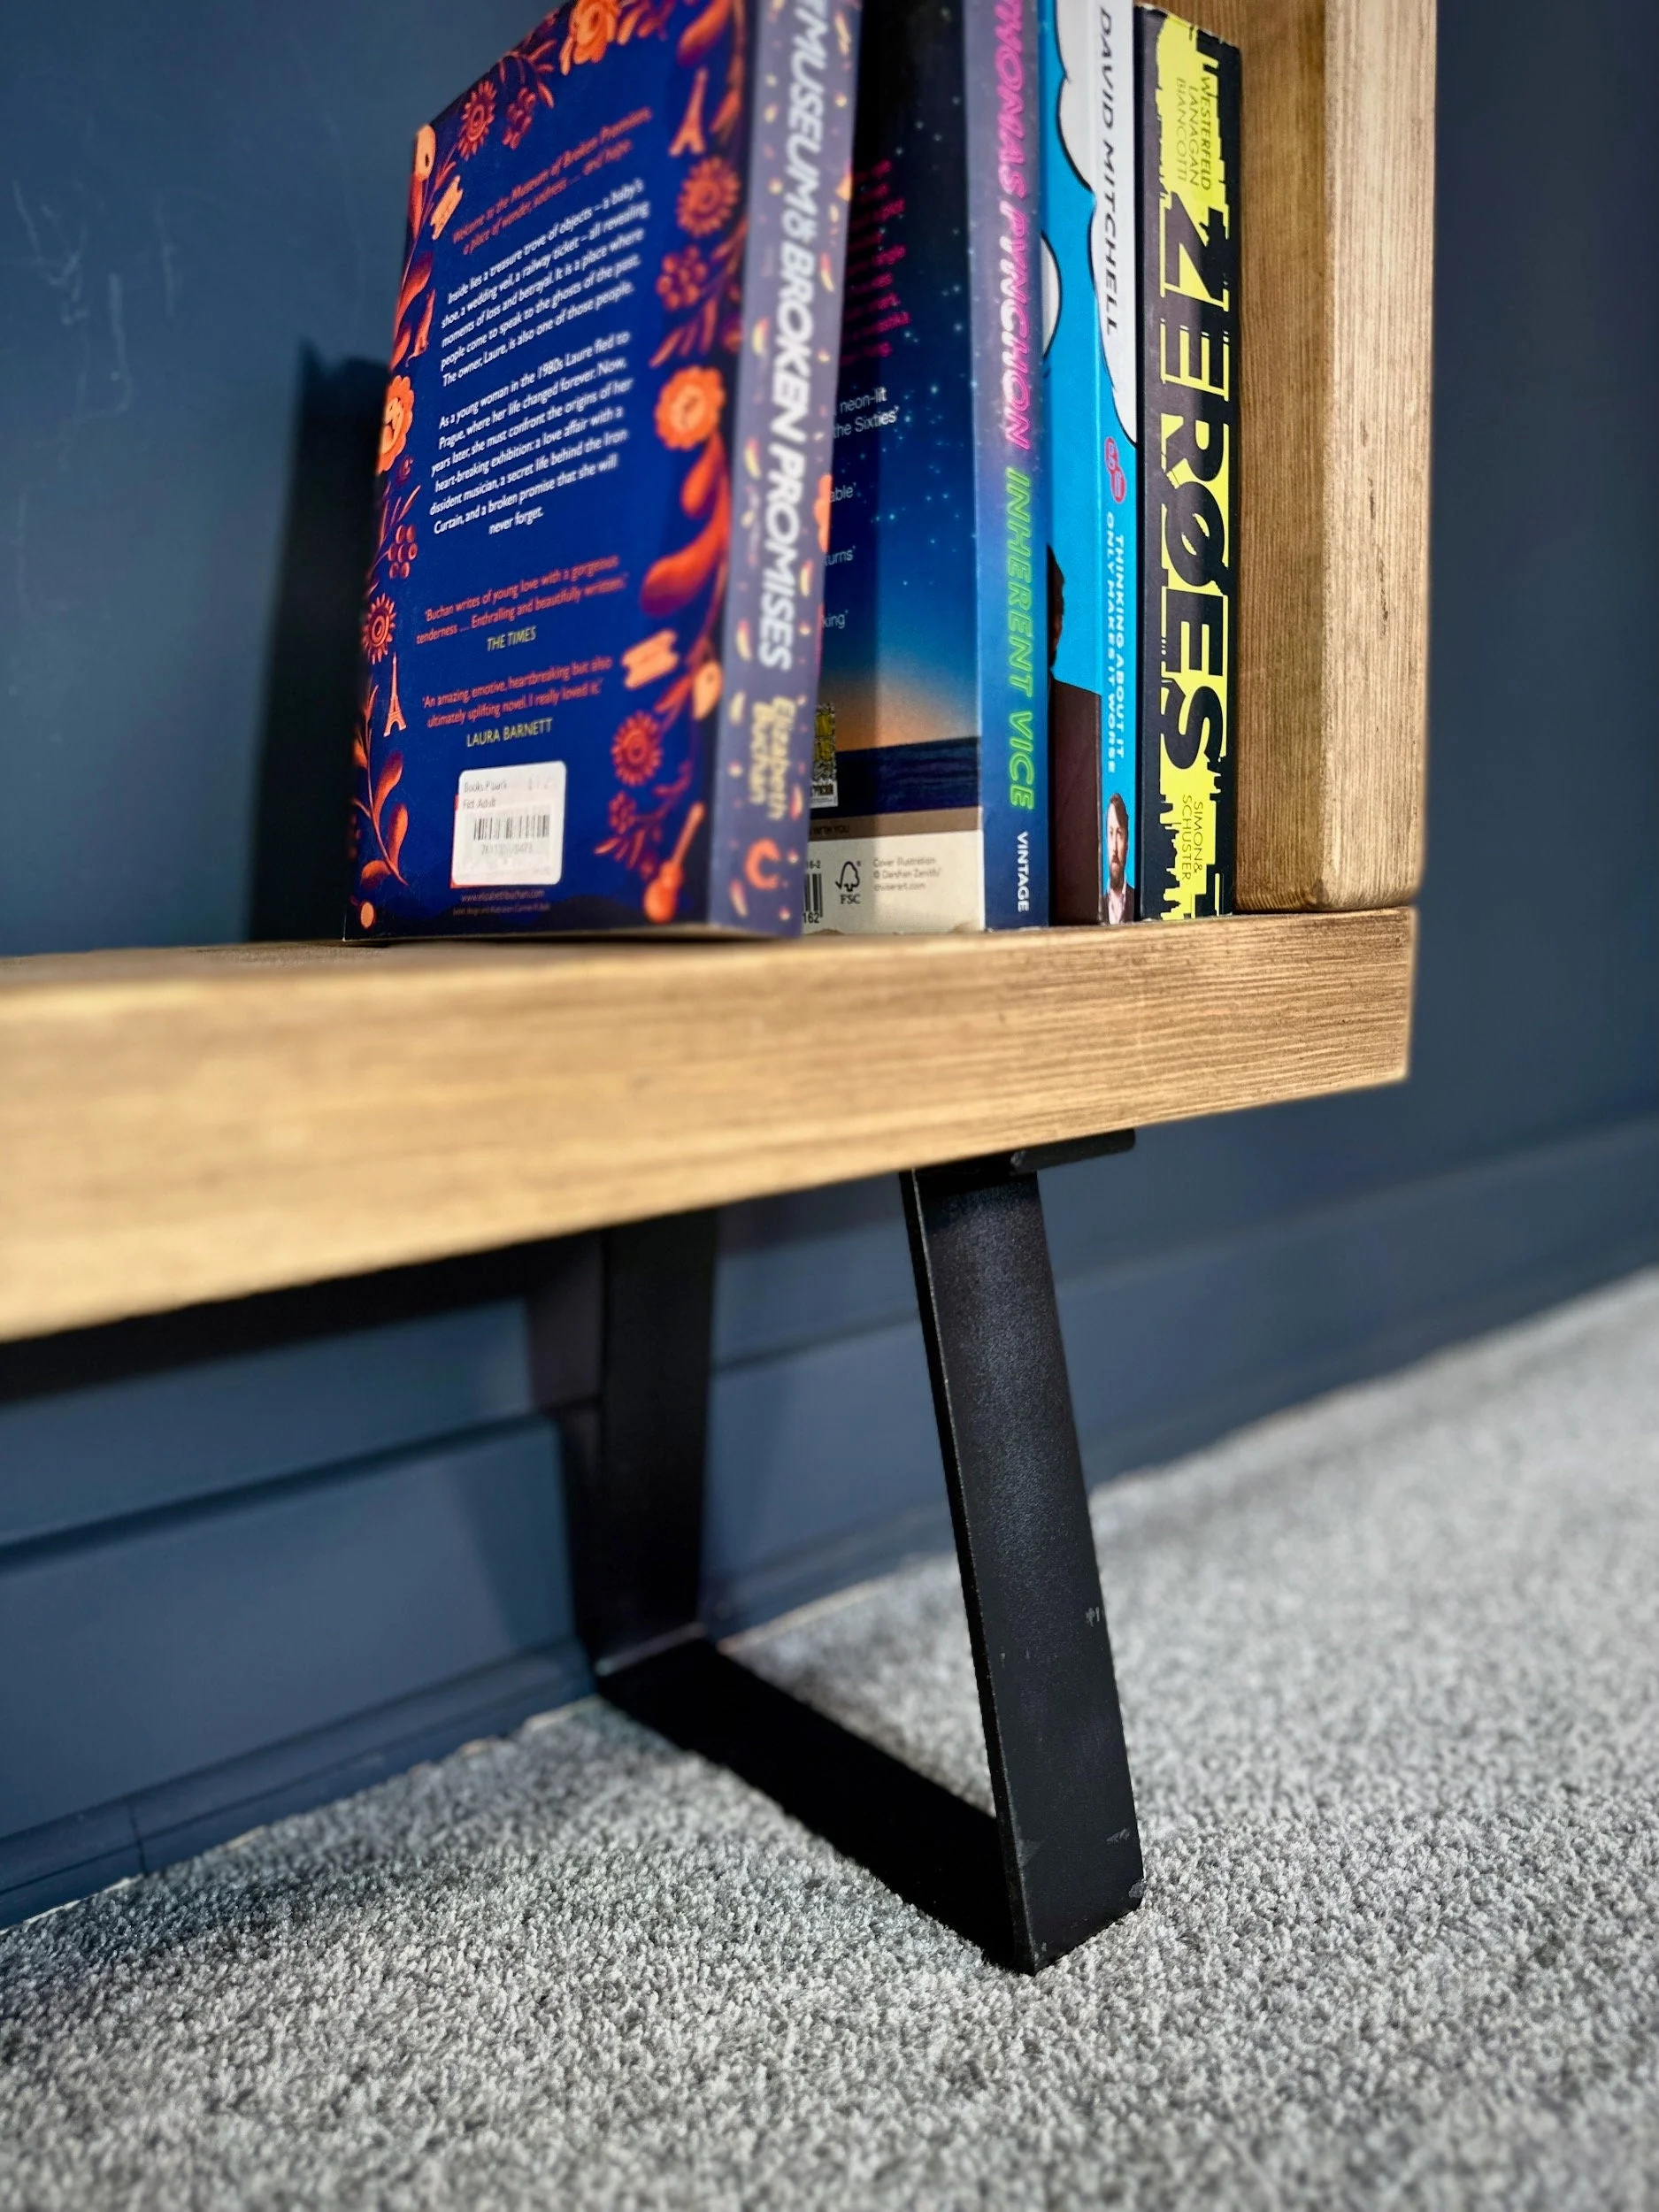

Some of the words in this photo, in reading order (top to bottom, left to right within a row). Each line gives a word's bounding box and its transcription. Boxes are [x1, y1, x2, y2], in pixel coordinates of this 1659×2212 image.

[784, 7, 828, 215] MUSEUM
[1100, 6, 1114, 130] DAVID
[1175, 76, 1188, 182] BIANCOTTI
[1187, 85, 1200, 187] LANAGAN
[1200, 76, 1211, 191] WESTERFELD
[442, 311, 461, 329] shoe,
[467, 286, 498, 311] wedding
[499, 273, 515, 292] veil,
[522, 254, 552, 278] railway
[552, 237, 580, 260] ticket
[588, 222, 602, 241] all
[448, 284, 469, 304] Inside
[470, 275, 483, 290] lies
[489, 250, 523, 277] treasure
[523, 234, 548, 256] trove
[547, 223, 560, 241] of
[558, 208, 593, 234] objects
[1102, 139, 1118, 336] MITCHELL
[441, 346, 465, 372] people
[466, 334, 488, 353] come
[488, 328, 498, 341] to
[499, 312, 522, 336] speak
[524, 308, 534, 320] to
[535, 298, 551, 314] the
[551, 282, 582, 310] ghosts
[583, 272, 598, 289] of
[596, 266, 614, 283] the
[442, 321, 475, 348] moments
[475, 310, 487, 327] of
[486, 305, 502, 321] loss
[502, 292, 518, 311] and
[518, 273, 554, 302] betrayal.
[555, 268, 564, 281] It
[565, 264, 573, 276] is
[580, 246, 608, 271] place
[442, 373, 457, 387] The
[457, 357, 483, 379] owner,
[482, 344, 509, 365] Laure,
[509, 338, 518, 350] is
[517, 329, 535, 346] also
[535, 319, 555, 336] one
[554, 308, 567, 326] of
[566, 299, 595, 320] those
[769, 240, 816, 442] BROKEN
[999, 200, 1031, 451] PYNCHON
[431, 457, 451, 478] years
[452, 448, 472, 465] later,
[471, 441, 486, 456] she
[487, 430, 508, 448] must
[508, 413, 546, 438] confront
[546, 406, 564, 421] the
[565, 393, 598, 413] origins
[598, 381, 614, 400] of
[439, 416, 449, 430] As
[449, 414, 456, 424] a
[456, 401, 480, 425] young
[480, 386, 510, 407] woman
[510, 380, 520, 393] in
[519, 373, 536, 388] the
[537, 357, 564, 380] 1980s
[564, 346, 594, 367] Laure
[439, 430, 466, 450] Prague,
[466, 417, 491, 435] where
[492, 409, 507, 424] her
[508, 400, 521, 416] life
[522, 382, 559, 409] changed
[559, 370, 595, 392] forever.
[840, 386, 887, 414] neon-lit
[429, 494, 463, 516] dissident
[463, 480, 501, 502] musician,
[507, 464, 534, 484] secret
[535, 456, 549, 472] life
[550, 442, 583, 466] behind
[583, 438, 603, 453] the
[434, 461, 490, 493] heart-breaking
[490, 442, 534, 468] exhibition:
[534, 439, 541, 449] a
[542, 430, 563, 446] love
[564, 419, 588, 437] affair
[590, 408, 614, 426] with
[434, 515, 465, 534] Curtain,
[465, 504, 480, 523] and
[488, 494, 518, 513] broken
[518, 479, 556, 505] promise
[556, 471, 578, 488] that
[577, 464, 597, 480] she
[488, 518, 514, 535] never
[514, 507, 544, 526] forget.
[1106, 511, 1115, 574] ONLY
[757, 442, 806, 672] PROMISES
[1005, 466, 1033, 698] INHERENT
[1115, 534, 1125, 649] THINKING
[487, 634, 506, 651] THE
[507, 626, 536, 646] TIMES
[1106, 580, 1116, 660] MAKES
[1107, 665, 1116, 687] IT
[1115, 653, 1125, 733] ABOUT
[466, 729, 501, 748] LAURA
[503, 718, 553, 741] BARNETT
[749, 701, 773, 806] Buchan
[766, 695, 795, 821] Elizabeth
[1008, 710, 1034, 810] VICE
[1117, 737, 1125, 758] IT
[872, 856, 894, 867] Cover
[1017, 831, 1030, 912] VINTAGE
[1181, 794, 1194, 880] SCHUSTER
[840, 894, 861, 905] FSC
